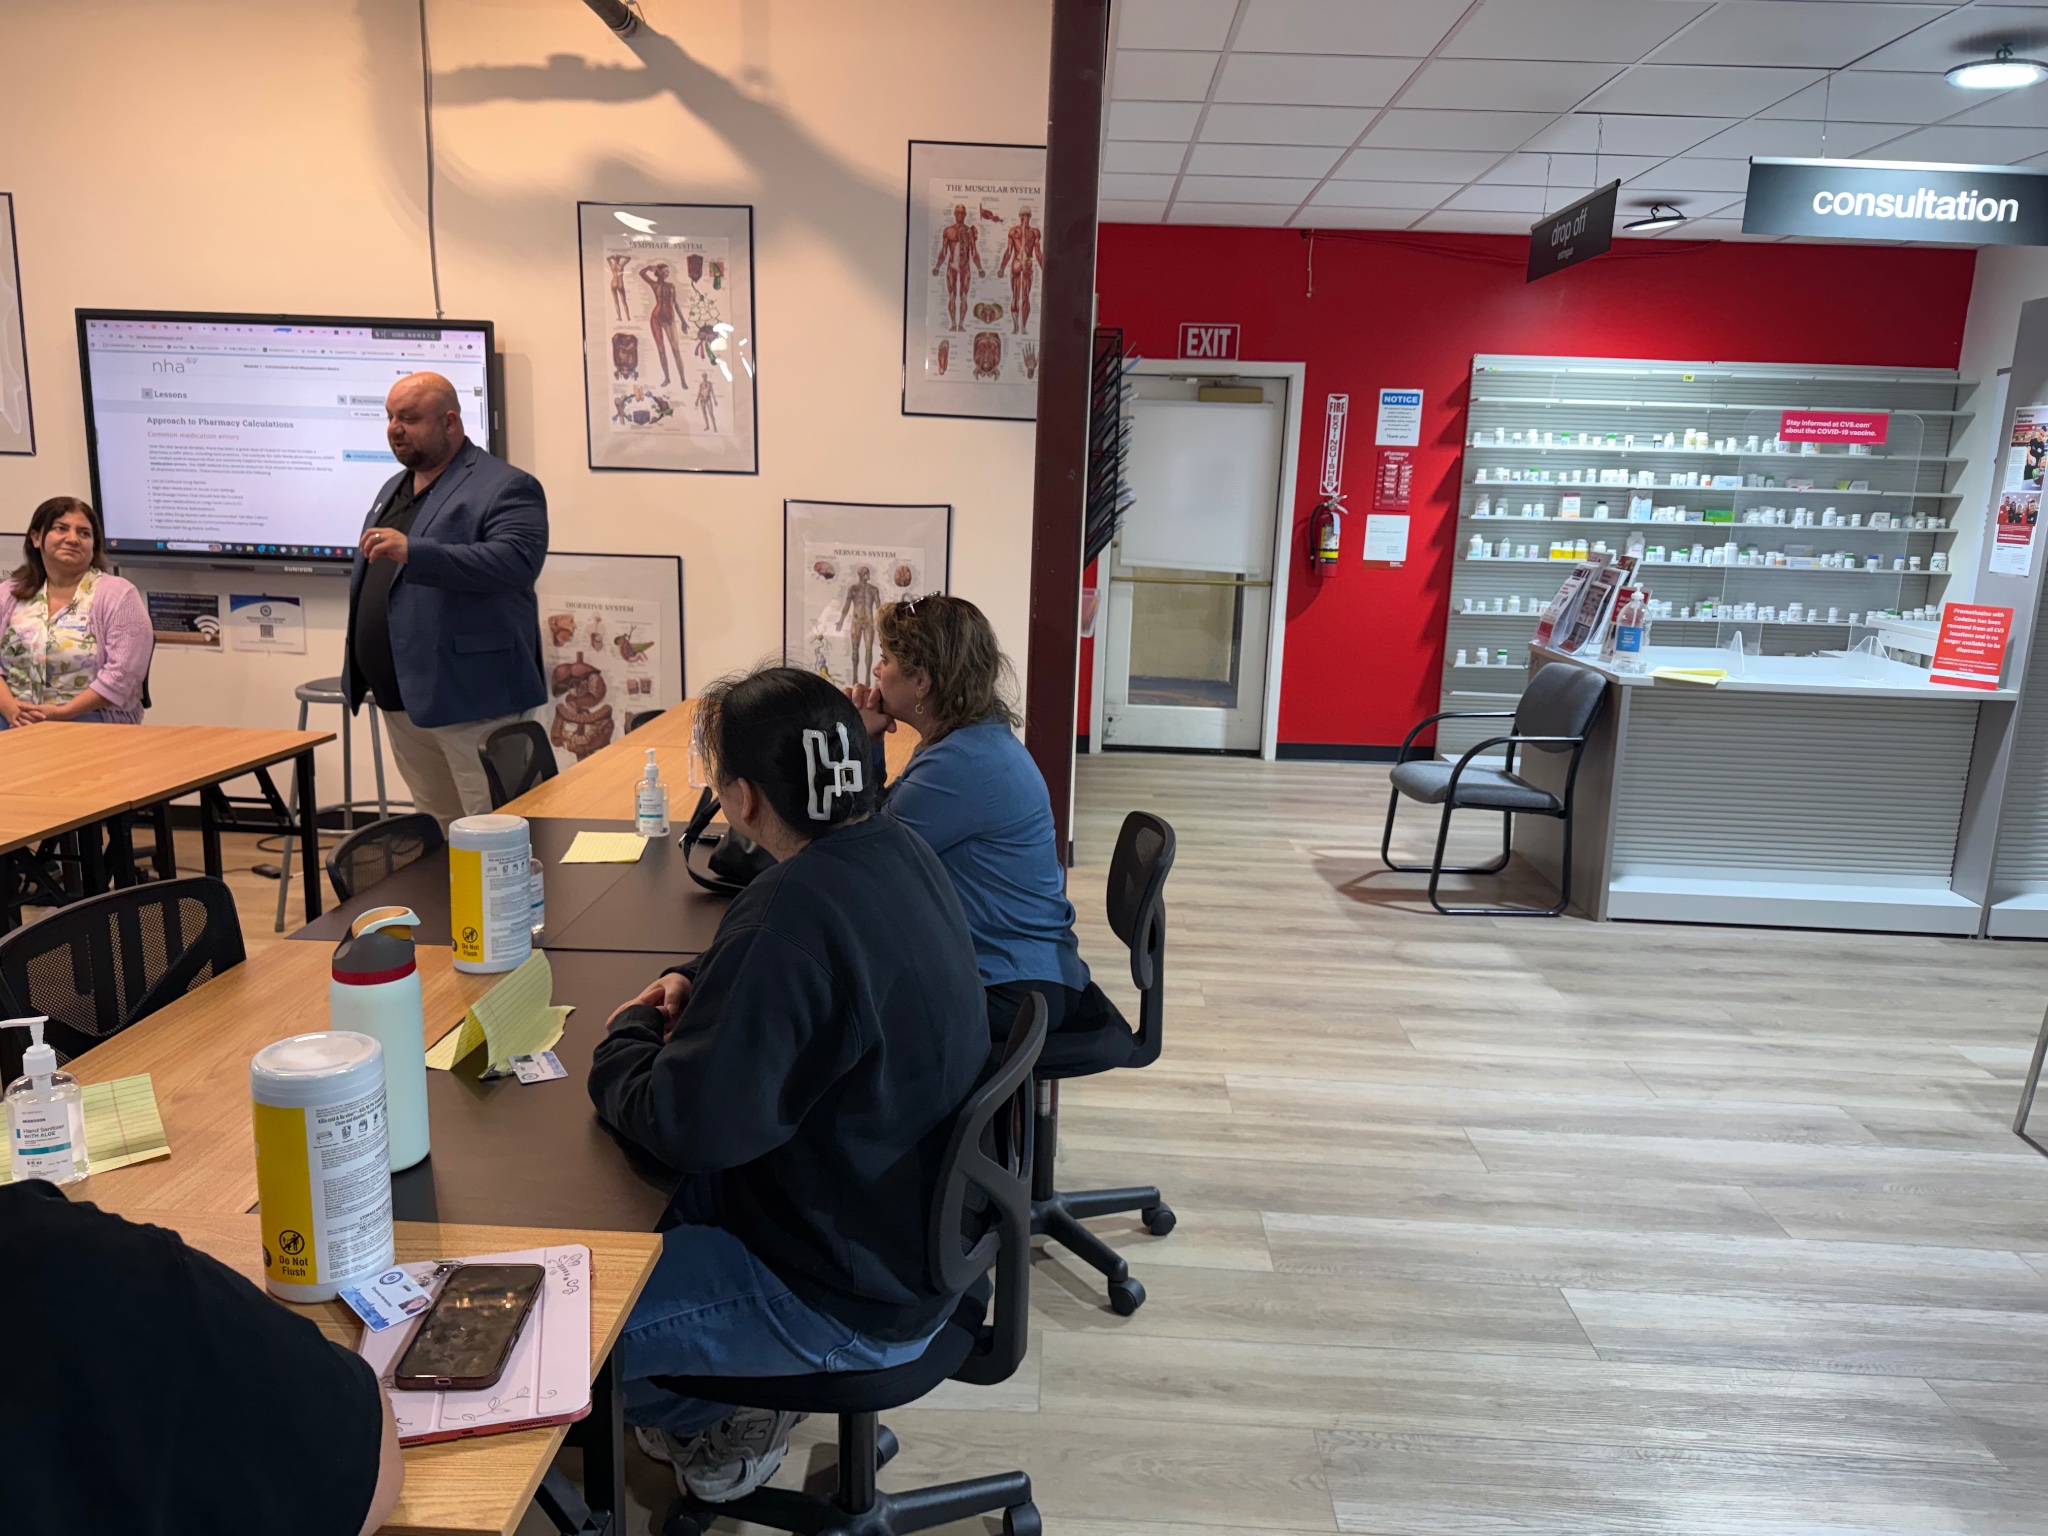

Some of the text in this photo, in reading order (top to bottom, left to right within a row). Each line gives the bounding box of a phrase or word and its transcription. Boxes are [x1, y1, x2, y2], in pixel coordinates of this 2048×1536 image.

[945, 184, 1041, 195] THE MUSCULAR SYSTEM
[1812, 187, 2019, 223] consultation
[1551, 207, 1588, 247] drop off
[673, 242, 703, 250] SYSTEM
[1186, 327, 1231, 357] EXIT
[152, 359, 185, 374] nha
[154, 390, 188, 399] Lessons
[1384, 395, 1418, 404] NOTICE
[1329, 401, 1345, 413] FIRE
[147, 417, 186, 426] Approach
[198, 418, 240, 428] Pharmacy
[242, 419, 294, 429] Calculations
[1786, 419, 1801, 427] Stay
[1801, 420, 1831, 428] informed
[179, 432, 217, 440] medication
[1817, 428, 1849, 436] COVID-19
[1849, 429, 1877, 437] vaccine.
[1326, 414, 1339, 487] EXTINGUISHER
[833, 549, 867, 557] NERVOUS
[565, 601, 634, 613] DIGESTIVE SYSTEM
[1953, 608, 1992, 617] Promethazine
[1943, 637, 1961, 645] longer
[1956, 647, 1985, 655] dispensed.
[40, 1124, 65, 1132] Sanitizer
[279, 1255, 308, 1267] Do Not
[282, 1266, 306, 1277] Flush
